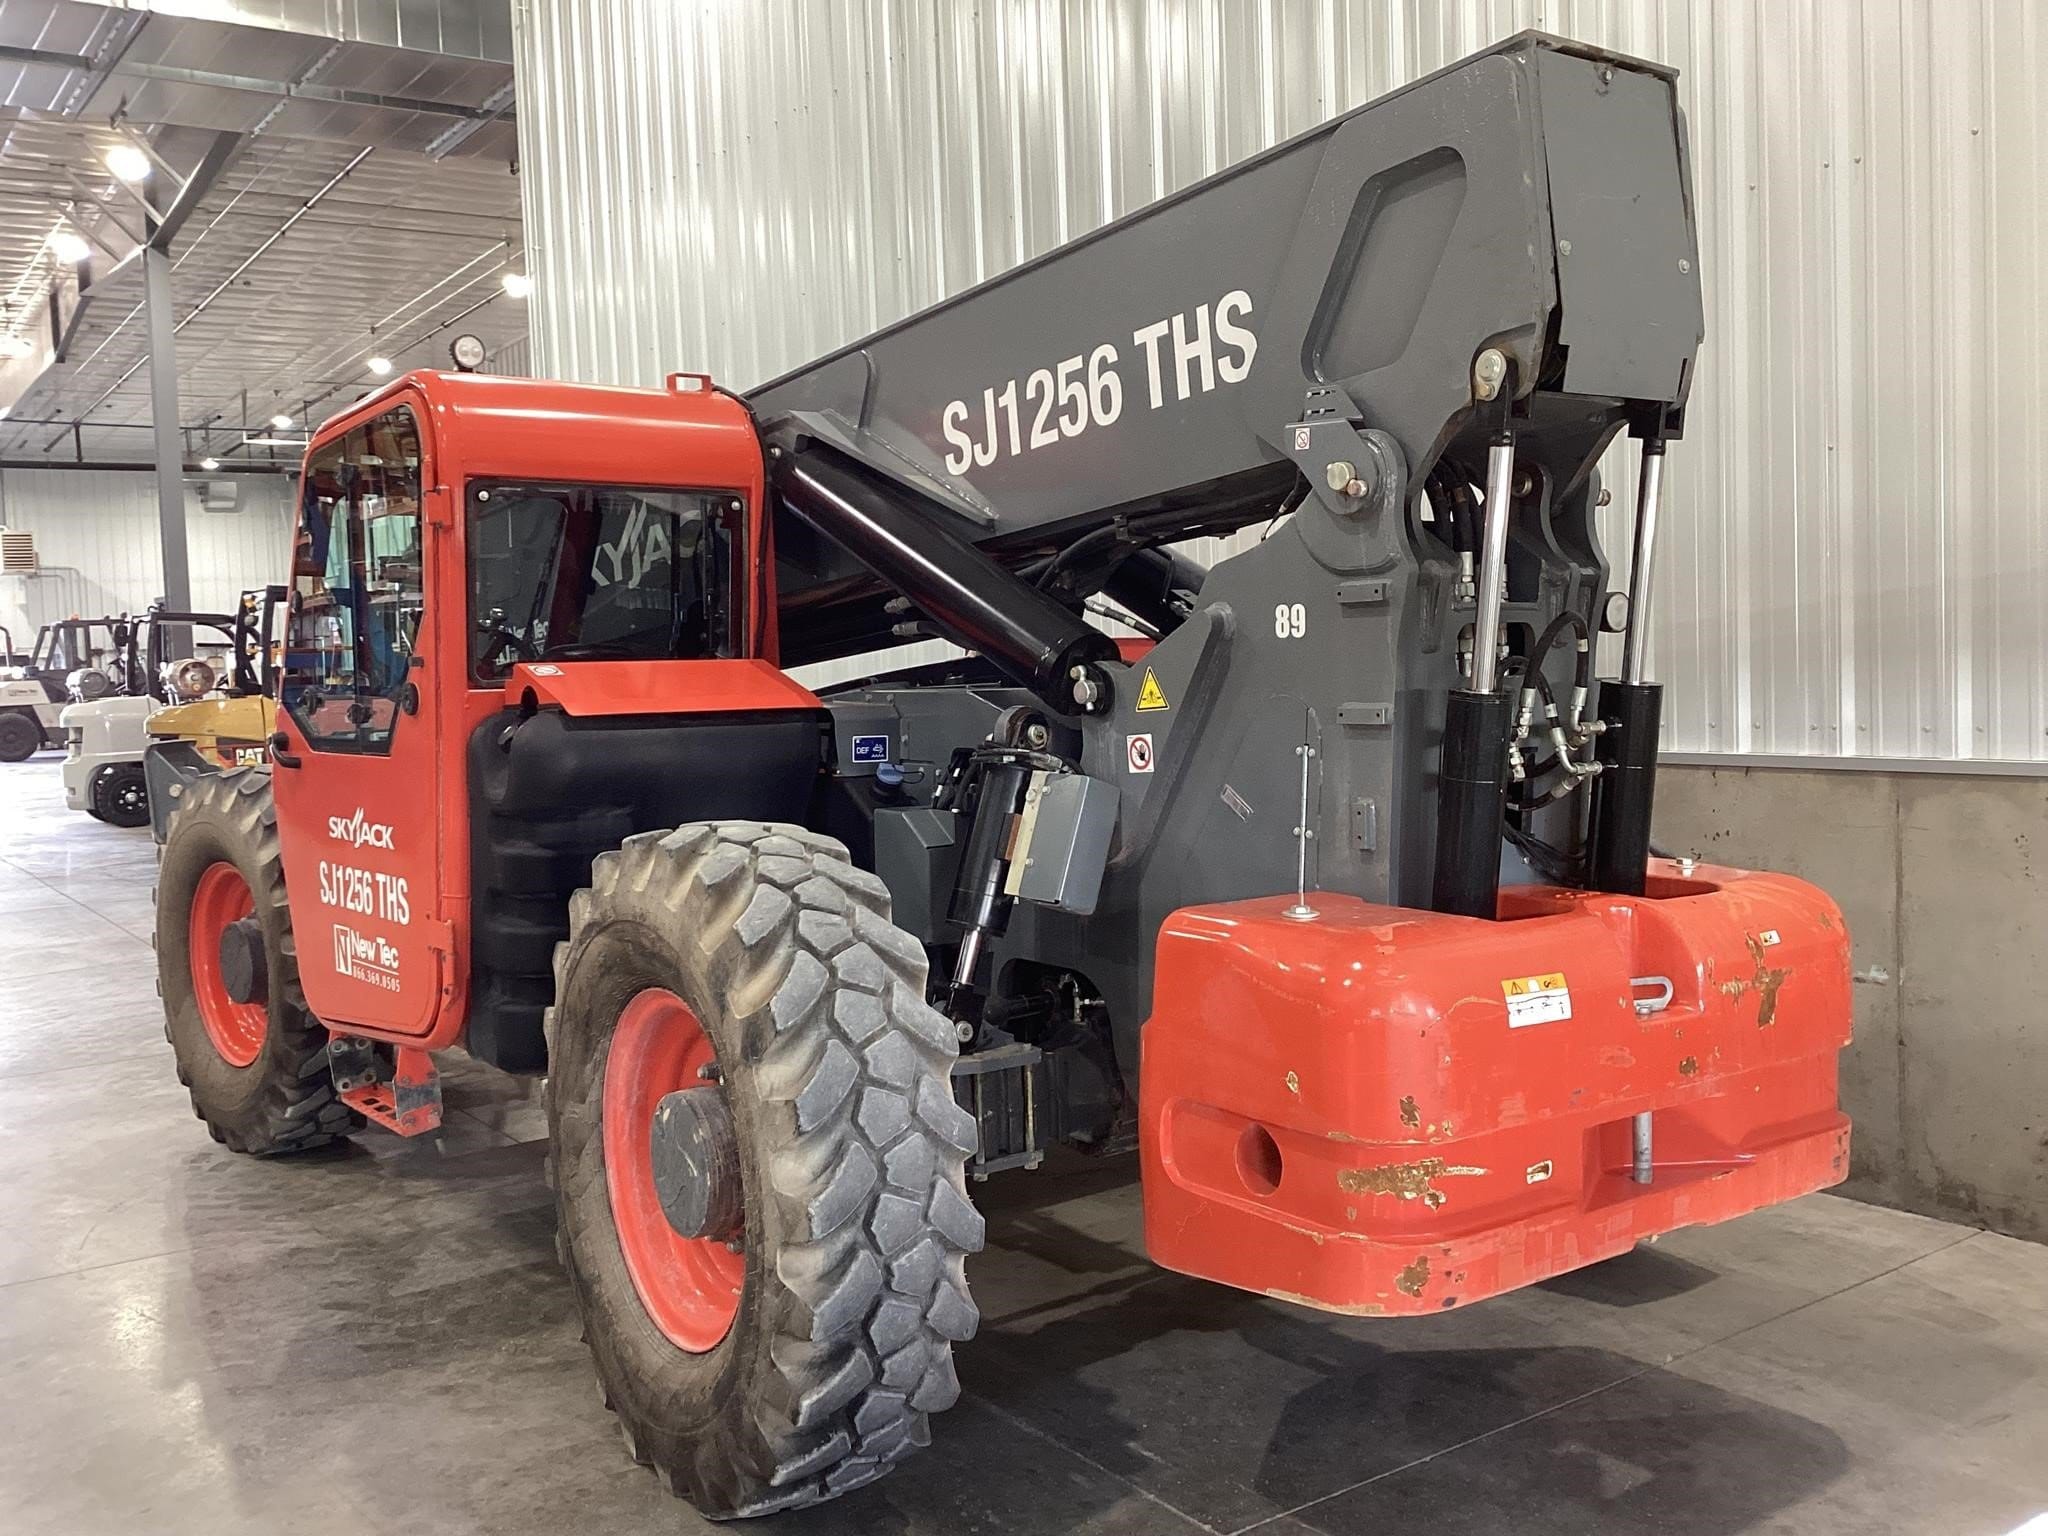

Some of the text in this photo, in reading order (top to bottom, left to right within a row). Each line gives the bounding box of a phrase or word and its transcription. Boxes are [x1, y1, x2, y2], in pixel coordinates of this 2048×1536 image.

[942, 289, 1258, 476] SJ1256 THS
[1274, 603, 1306, 638] 89
[235, 747, 264, 767] CAT
[857, 746, 869, 754] DEF
[328, 807, 394, 849] SKYJACK
[319, 860, 410, 925] SJ1256 THS
[351, 930, 376, 962] New
[376, 936, 399, 969] Tec
